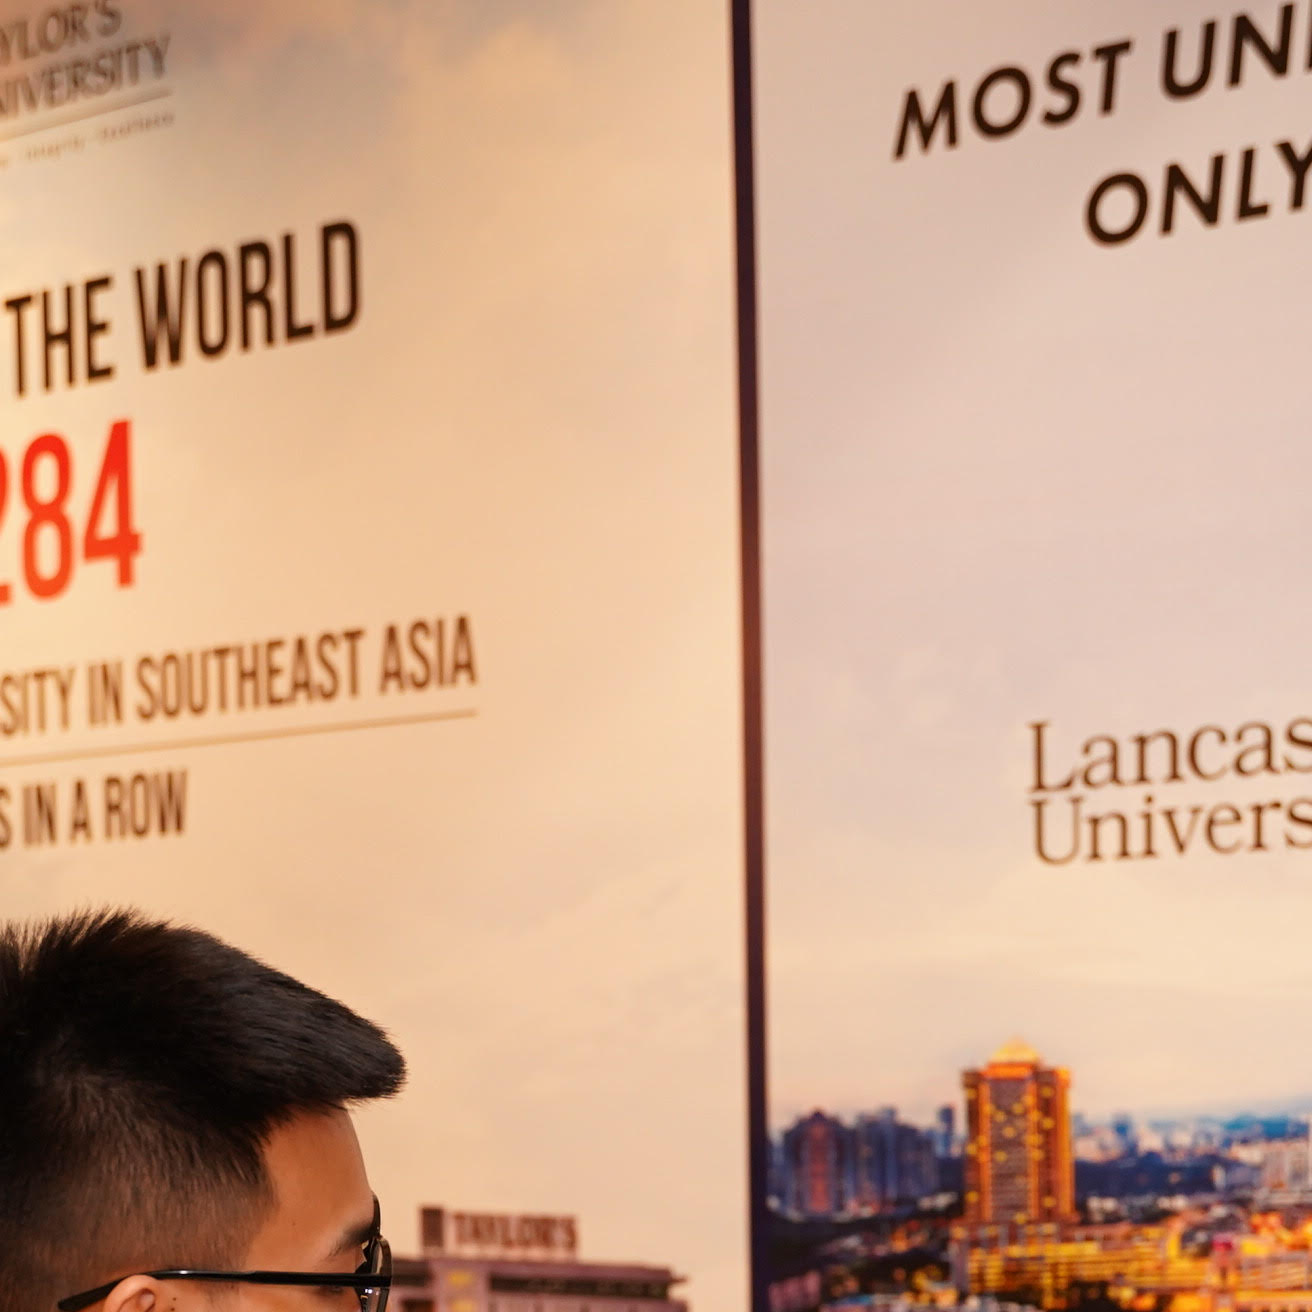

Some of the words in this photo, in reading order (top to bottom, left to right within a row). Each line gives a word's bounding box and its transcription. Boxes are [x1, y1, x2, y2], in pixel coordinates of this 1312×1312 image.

[894, 39, 1132, 161] MOST
[4, 276, 114, 397] THE
[134, 218, 362, 371] WORLD
[88, 659, 124, 729] IN
[136, 626, 365, 723] SOUTHEAST
[379, 614, 478, 696] ASIA
[22, 782, 58, 849] IN
[69, 778, 94, 846] A
[104, 768, 189, 841] ROW
